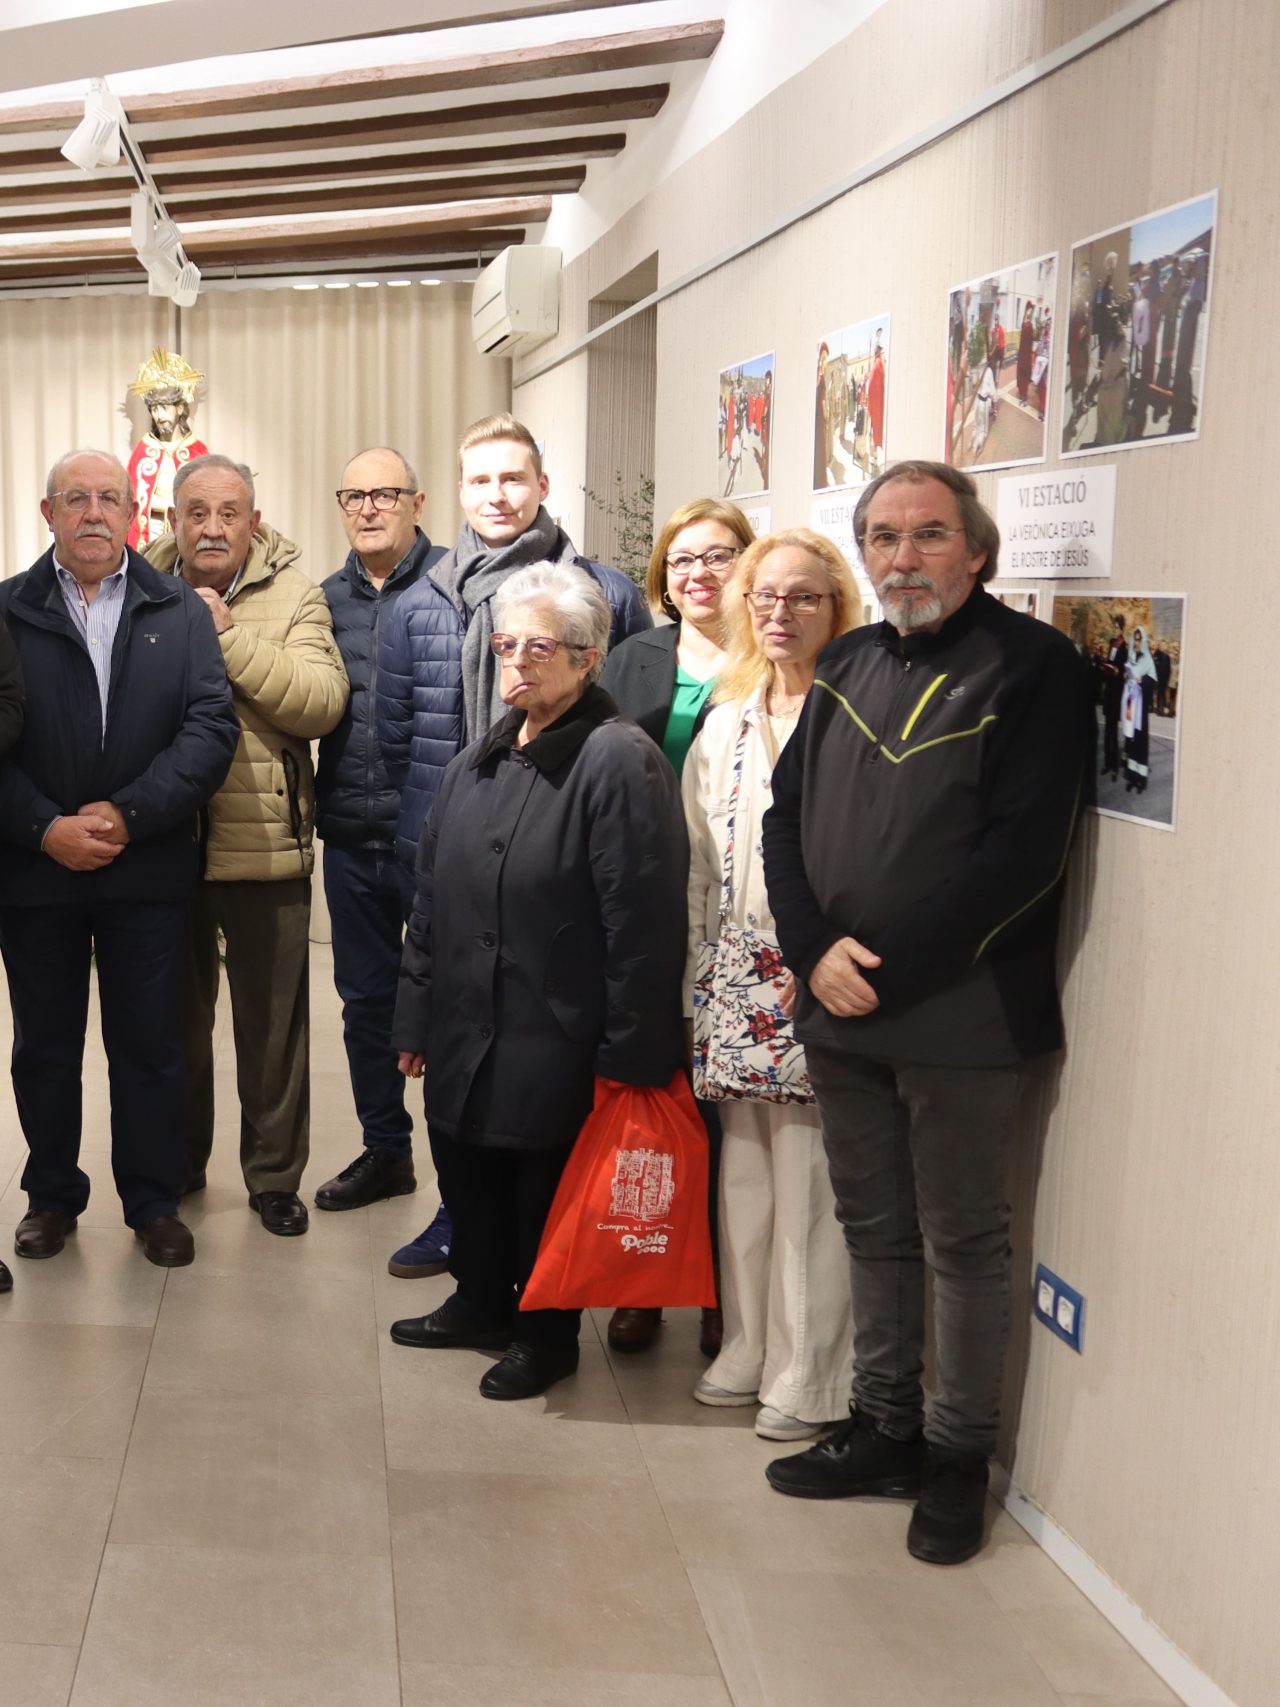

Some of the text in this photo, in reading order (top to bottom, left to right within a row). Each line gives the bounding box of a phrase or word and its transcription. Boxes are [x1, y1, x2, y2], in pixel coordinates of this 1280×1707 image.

[1018, 474, 1087, 507] VI ESTACIÓ
[1009, 525, 1018, 541] LA
[1061, 520, 1096, 539] EIXUGA
[1021, 550, 1049, 568] ROSTRE
[1050, 550, 1062, 567] DE
[1062, 544, 1089, 567] JESÚS
[597, 1223, 630, 1234] Compra
